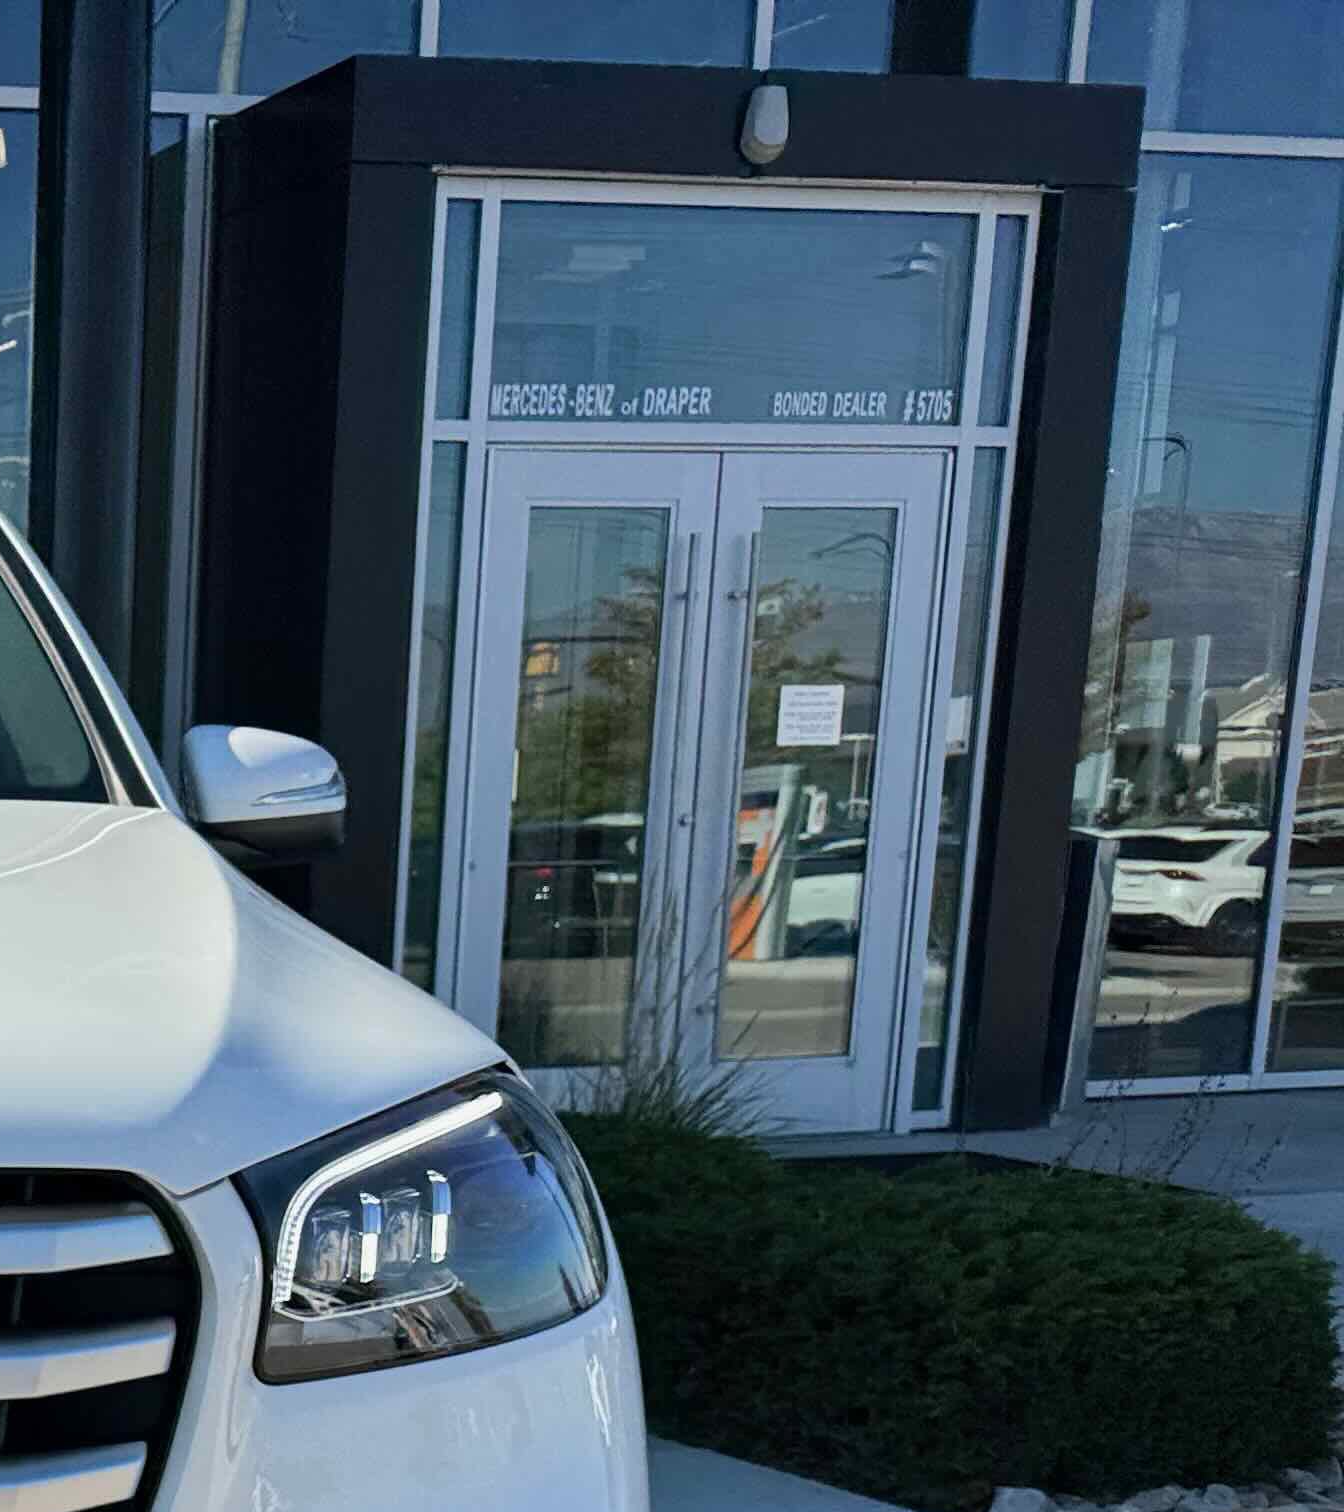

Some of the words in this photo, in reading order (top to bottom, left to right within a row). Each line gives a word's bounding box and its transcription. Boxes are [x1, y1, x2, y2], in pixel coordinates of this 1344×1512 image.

[490, 384, 615, 416] MERCEDES-BENZ
[621, 397, 639, 415] of
[643, 387, 712, 415] DRAPER
[773, 391, 828, 417] BONDED
[832, 391, 888, 417] DEALER
